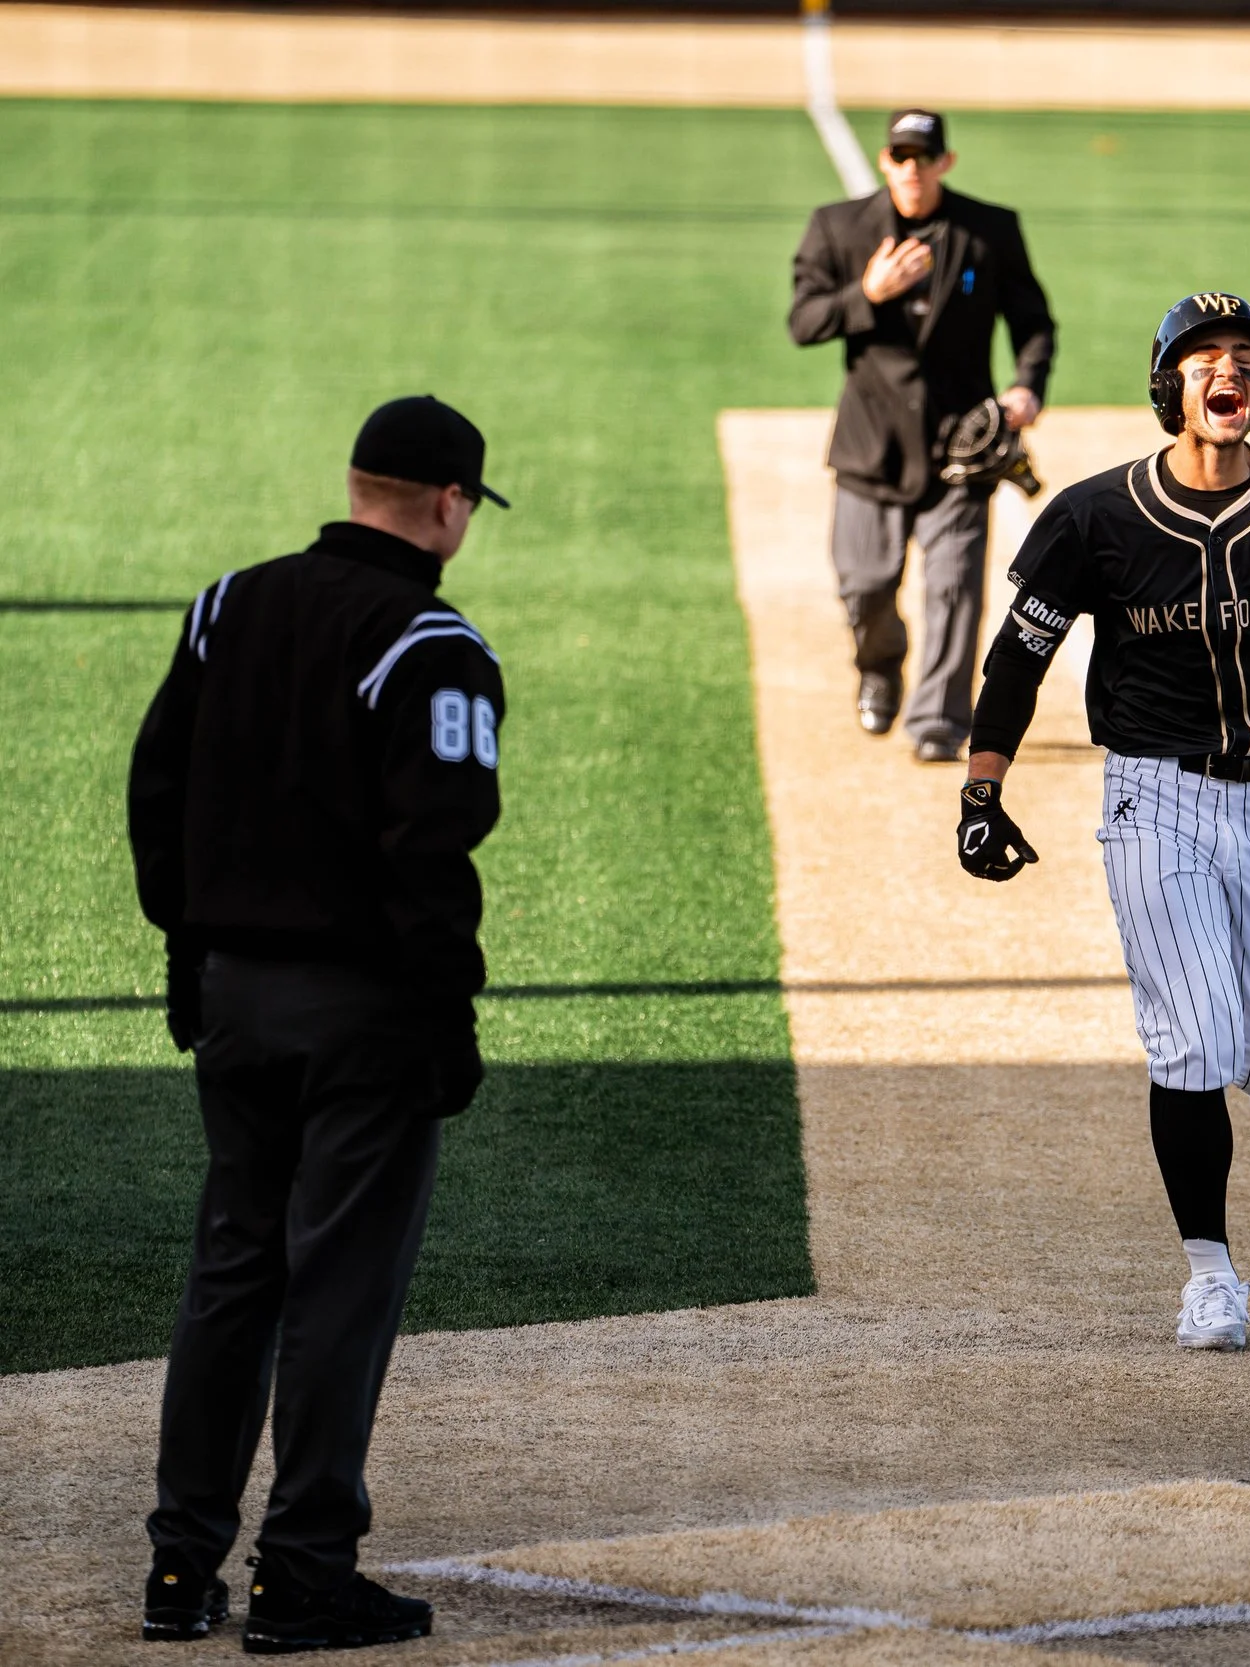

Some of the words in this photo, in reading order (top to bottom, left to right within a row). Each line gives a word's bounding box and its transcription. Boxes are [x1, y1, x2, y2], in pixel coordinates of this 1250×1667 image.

[1192, 292, 1241, 316] WF
[1009, 571, 1026, 588] ACC
[1126, 602, 1201, 635] WAKE
[1017, 628, 1055, 657] #31
[430, 687, 499, 770] 86
